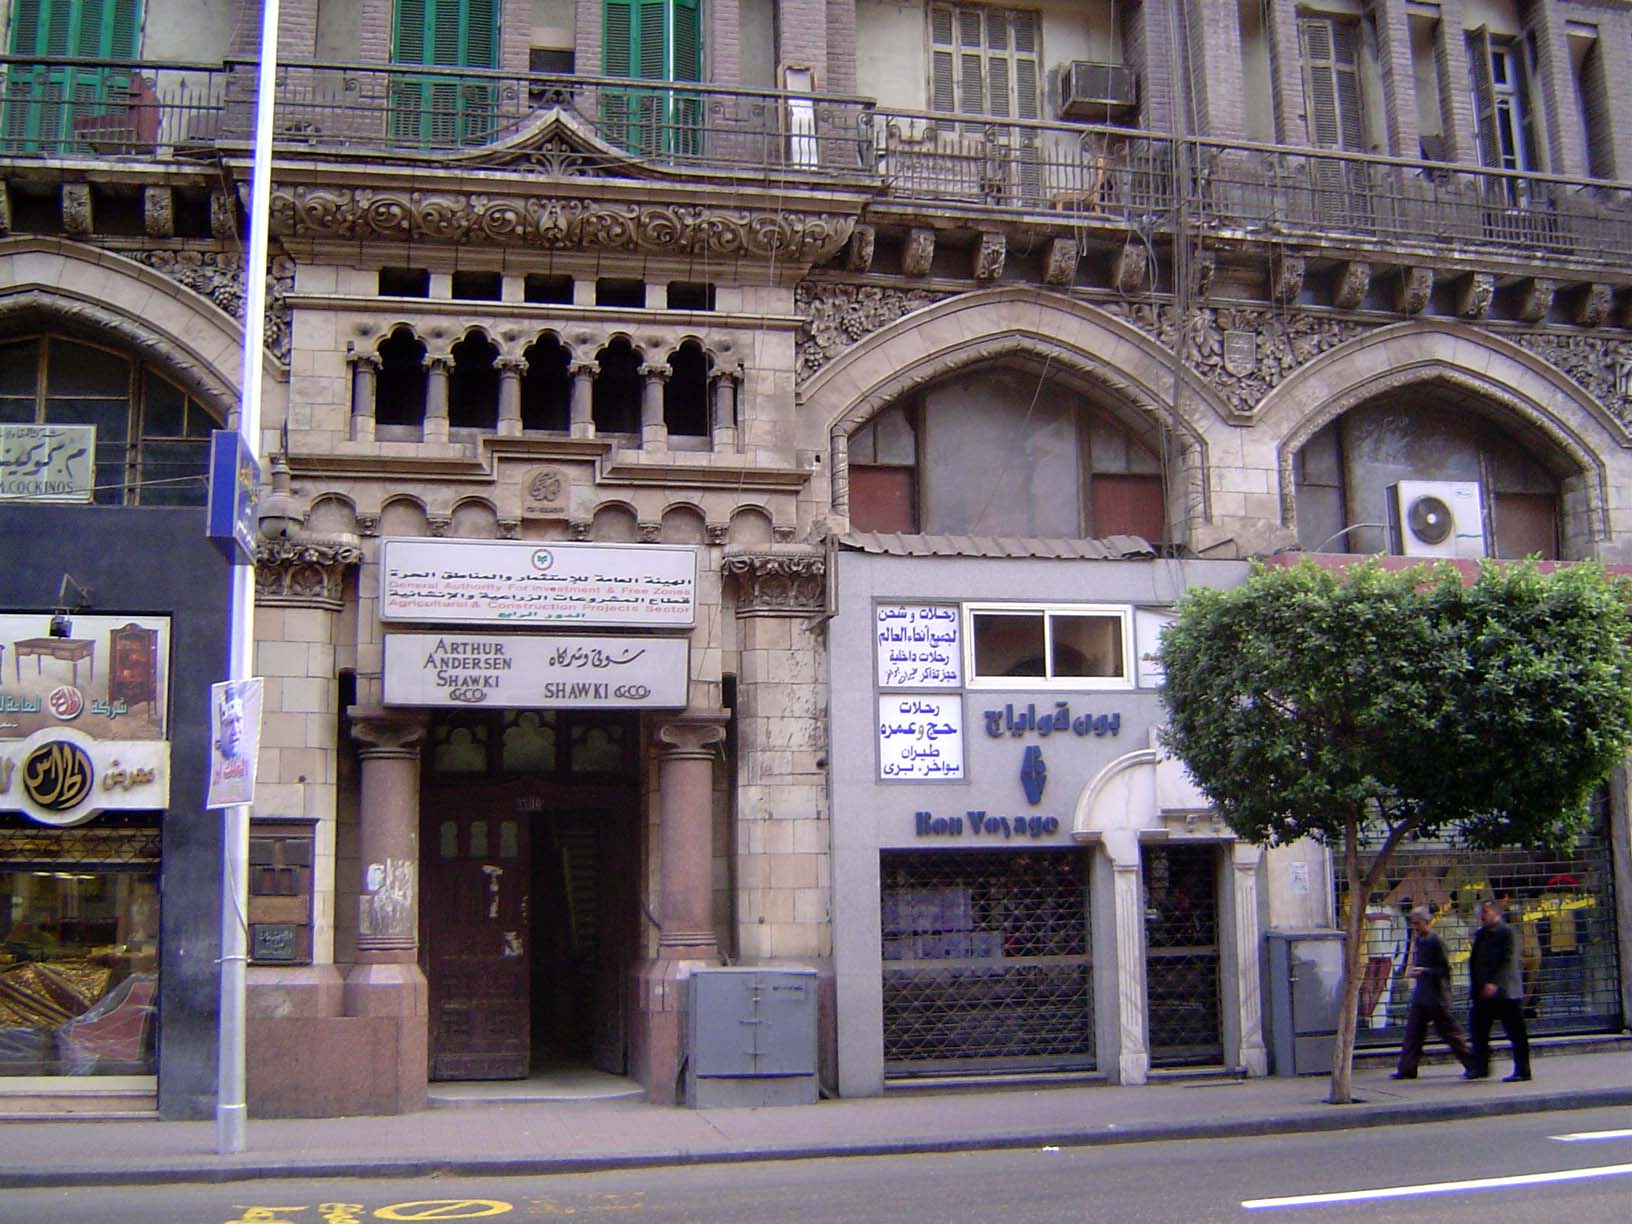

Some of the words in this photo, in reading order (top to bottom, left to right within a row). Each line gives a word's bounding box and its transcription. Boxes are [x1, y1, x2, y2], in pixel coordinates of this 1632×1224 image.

[389, 569, 436, 580] الحرة
[441, 571, 513, 583] والمناطق
[595, 574, 639, 585] العامة
[645, 575, 692, 587] الهيئة
[389, 581, 438, 590] General
[444, 582, 502, 592] Authority
[622, 586, 649, 594] Free
[653, 587, 690, 595] Zones
[480, 592, 547, 602] الزراعية
[553, 594, 644, 604] المشروعات
[649, 597, 690, 605] قطاع
[488, 601, 576, 611] Construction
[582, 603, 639, 614] Projects
[645, 605, 690, 614] Sector
[879, 606, 907, 621] شحن
[920, 607, 956, 623] رحلات
[909, 612, 915, 623] و
[879, 626, 907, 647] العالم
[930, 629, 956, 648] لجميع
[434, 638, 504, 655] ARTHUR
[424, 654, 512, 670] ANDERSEN
[889, 649, 917, 665] داخلية
[919, 650, 949, 665] رحلات
[436, 670, 500, 688] SHAWKI
[920, 667, 939, 682] تذاكر
[940, 668, 957, 682] حجز
[544, 683, 608, 700] SHAWKI
[90, 697, 128, 720] شركة
[899, 700, 940, 716] رحلات
[916, 724, 924, 740] و
[926, 722, 957, 740] حج
[901, 744, 940, 761] طيران
[103, 760, 156, 792] معرض
[915, 811, 963, 836] Bon
[967, 811, 1060, 839] Voyage
